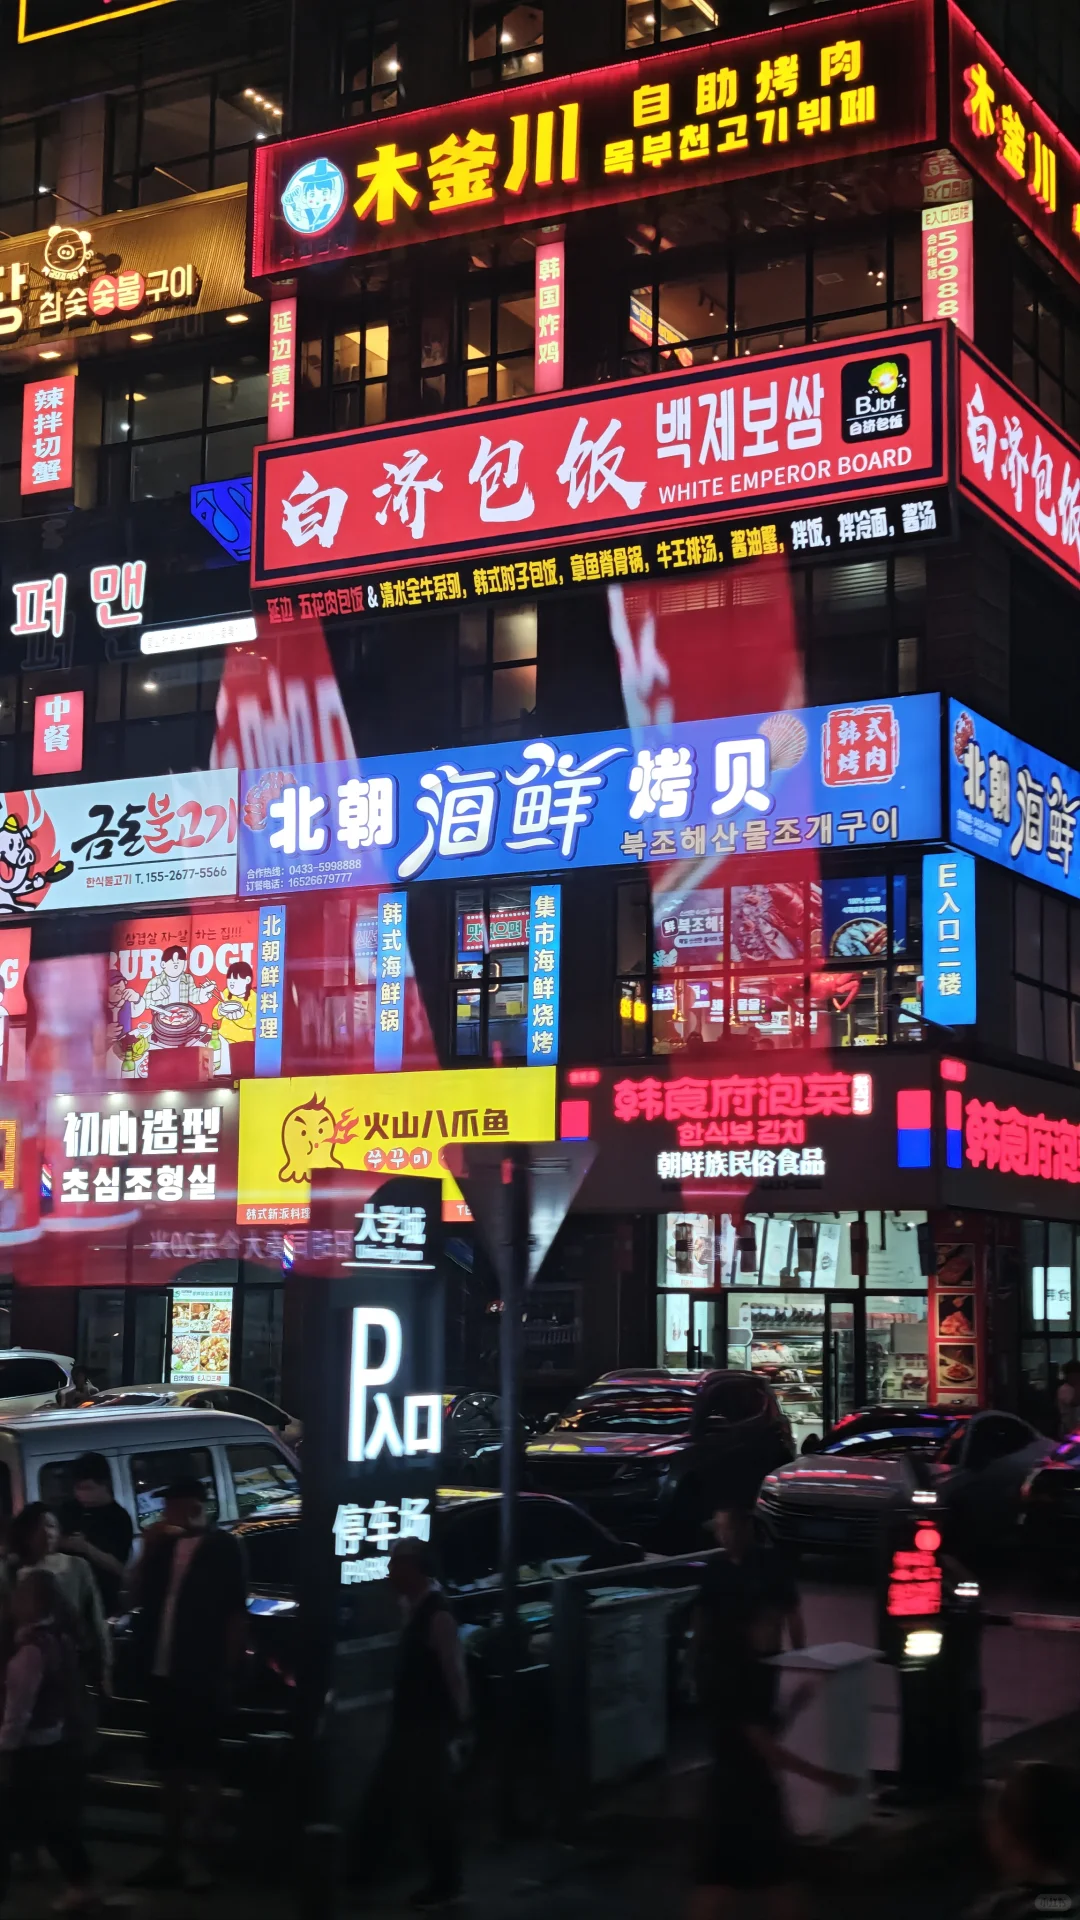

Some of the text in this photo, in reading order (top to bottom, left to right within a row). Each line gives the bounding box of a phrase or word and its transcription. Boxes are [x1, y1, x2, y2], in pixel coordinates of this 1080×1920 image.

[633, 39, 862, 127] 自助烤肉
[353, 103, 579, 223] 木釜川
[604, 85, 875, 174] 목부천고기뷔페
[966, 63, 1056, 213] 木釜川
[538, 256, 560, 365] 韩国炸鸡
[937, 229, 959, 324] 59988
[271, 311, 292, 412] 延边黄牛
[32, 387, 64, 485] 辣拌切蟹
[656, 373, 825, 469] 백제보쌈
[281, 418, 648, 549] 白济包饭
[659, 446, 913, 504] WHITE EMPEROR BOARD
[44, 696, 70, 752] 中餐
[837, 716, 888, 746] 韩式
[837, 745, 887, 776] 烤肉
[620, 806, 899, 860] 북조해산물조개구이
[86, 873, 132, 888] 한식불고기
[146, 866, 228, 884] 155-2677-5566
[288, 872, 352, 888] 16526679777
[125, 932, 157, 946] 삼겹살
[195, 928, 217, 941] 하는
[936, 862, 962, 998] E入口二楼
[259, 914, 282, 1040] 北朝鲜料理
[379, 902, 402, 1033] 韩式海鲜锅
[531, 894, 556, 1056] 集市海鲜烧烤
[63, 1106, 221, 1158] 初心造型
[363, 1108, 509, 1140] 火山八爪鱼
[368, 1148, 428, 1168] 쭈꾸미
[61, 1163, 216, 1203] 초심조형실
[657, 1148, 826, 1179] 朝鲜族民俗食品
[365, 1392, 442, 1460] 入口
[332, 1497, 431, 1556] 停车场
